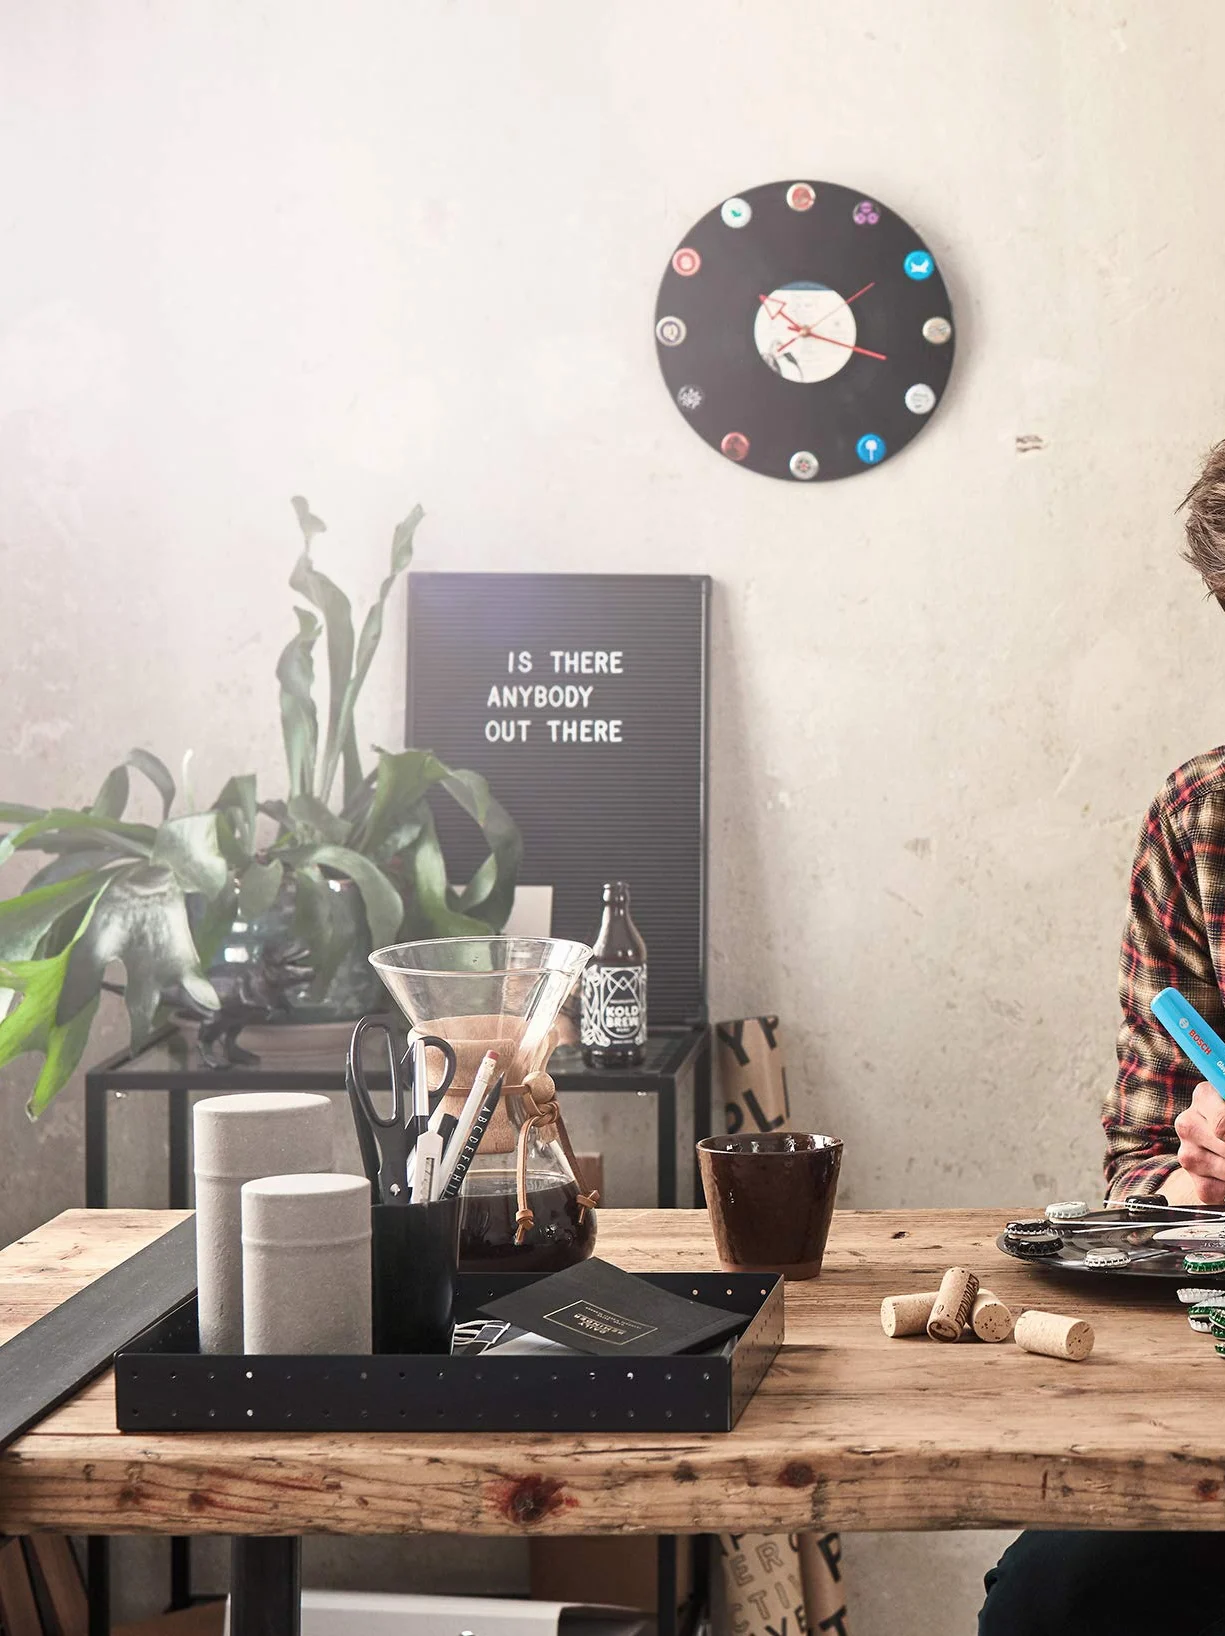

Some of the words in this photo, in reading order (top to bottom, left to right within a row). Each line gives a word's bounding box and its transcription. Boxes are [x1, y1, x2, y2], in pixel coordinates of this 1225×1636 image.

[508, 651, 533, 674] IS
[550, 651, 623, 674] THERE
[487, 685, 594, 708] ANYBODY
[485, 720, 531, 743] OUT
[546, 719, 623, 743] THERE
[606, 1006, 639, 1017] KOLD
[606, 1016, 639, 1028] BREW
[1189, 1029, 1212, 1055] BOSCH
